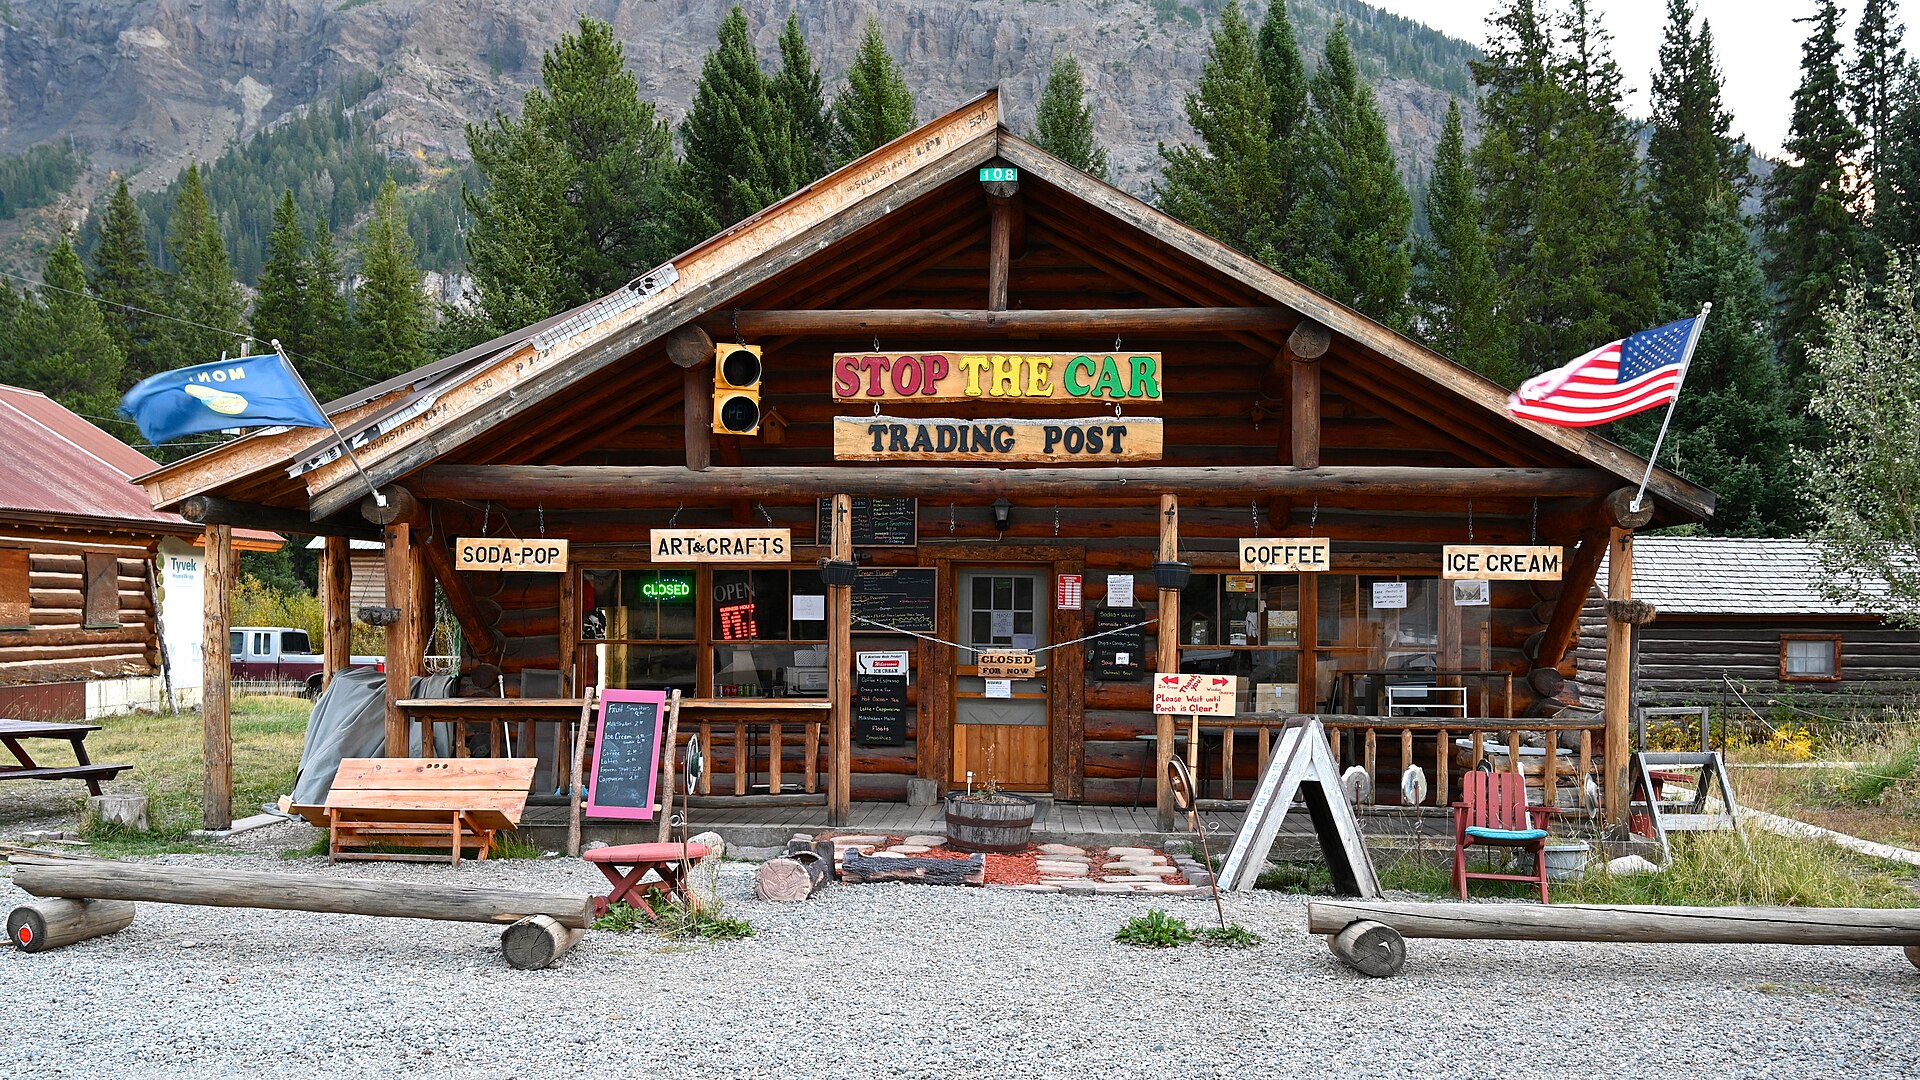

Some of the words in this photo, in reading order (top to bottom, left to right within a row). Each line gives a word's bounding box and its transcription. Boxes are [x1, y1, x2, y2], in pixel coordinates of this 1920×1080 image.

[983, 167, 1015, 181] 108
[834, 354, 950, 398] STOP
[958, 355, 1055, 397] THE
[1064, 355, 1161, 399] CAR
[868, 424, 1016, 454] TRADING
[1043, 425, 1128, 454] POST
[463, 545, 561, 565] SODA-POP
[1244, 545, 1326, 564] COFFEE
[170, 557, 197, 573] Tyvek
[1447, 553, 1480, 573] ICE
[1486, 553, 1559, 573] CREAM
[642, 583, 690, 596] CLOSED
[713, 582, 756, 602] OPEN
[981, 655, 1033, 664] CLOSED
[982, 667, 1001, 675] FOR
[1006, 667, 1029, 675] NOW
[1186, 695, 1203, 703] Wait
[1205, 695, 1221, 703] until
[1155, 703, 1176, 712] Porch
[1180, 704, 1187, 712] is
[614, 732, 632, 740] Cream
